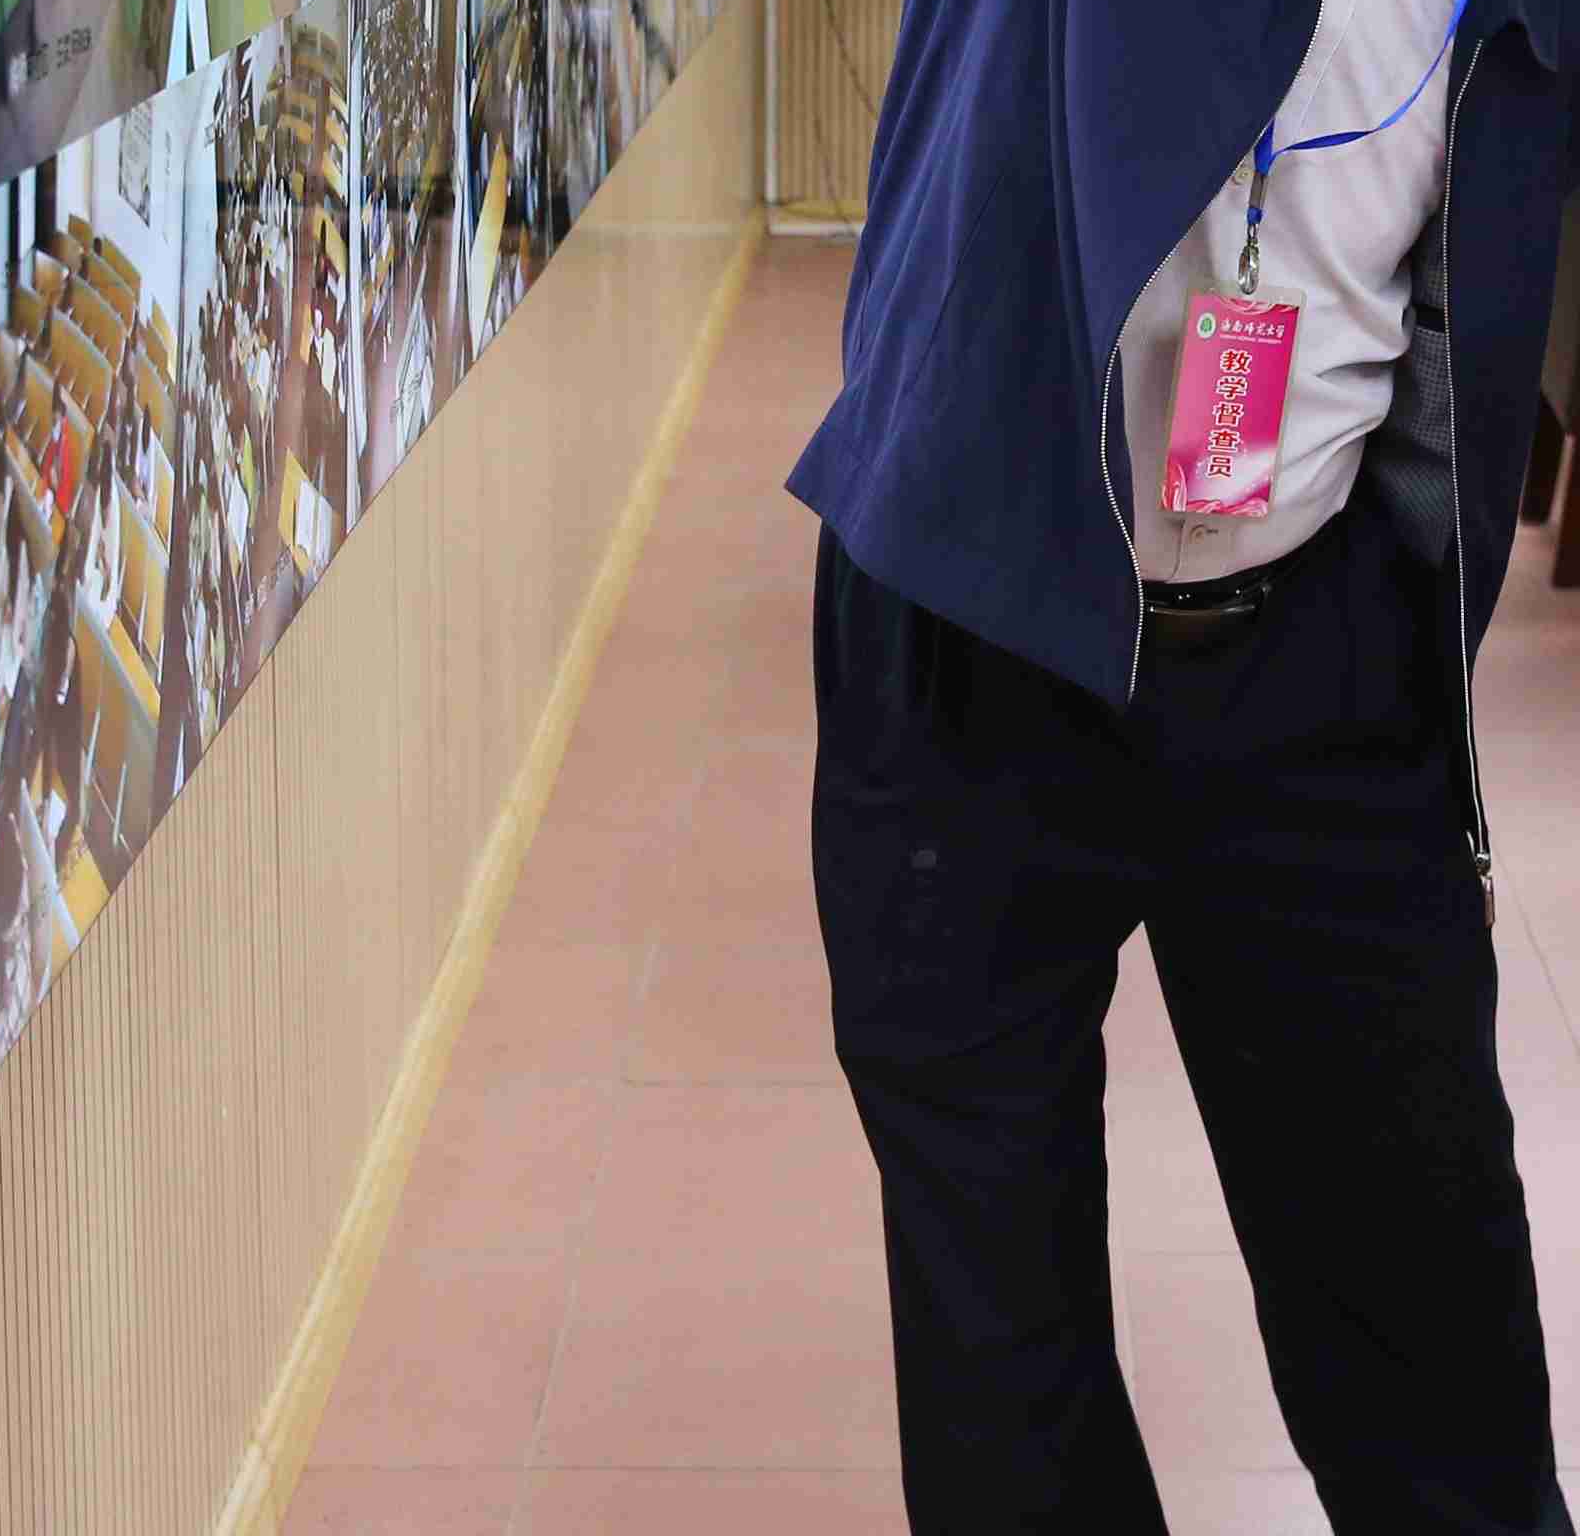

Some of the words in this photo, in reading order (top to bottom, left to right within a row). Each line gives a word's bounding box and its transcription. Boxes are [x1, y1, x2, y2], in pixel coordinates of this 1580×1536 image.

[1207, 349, 1252, 478] 教学督查员
